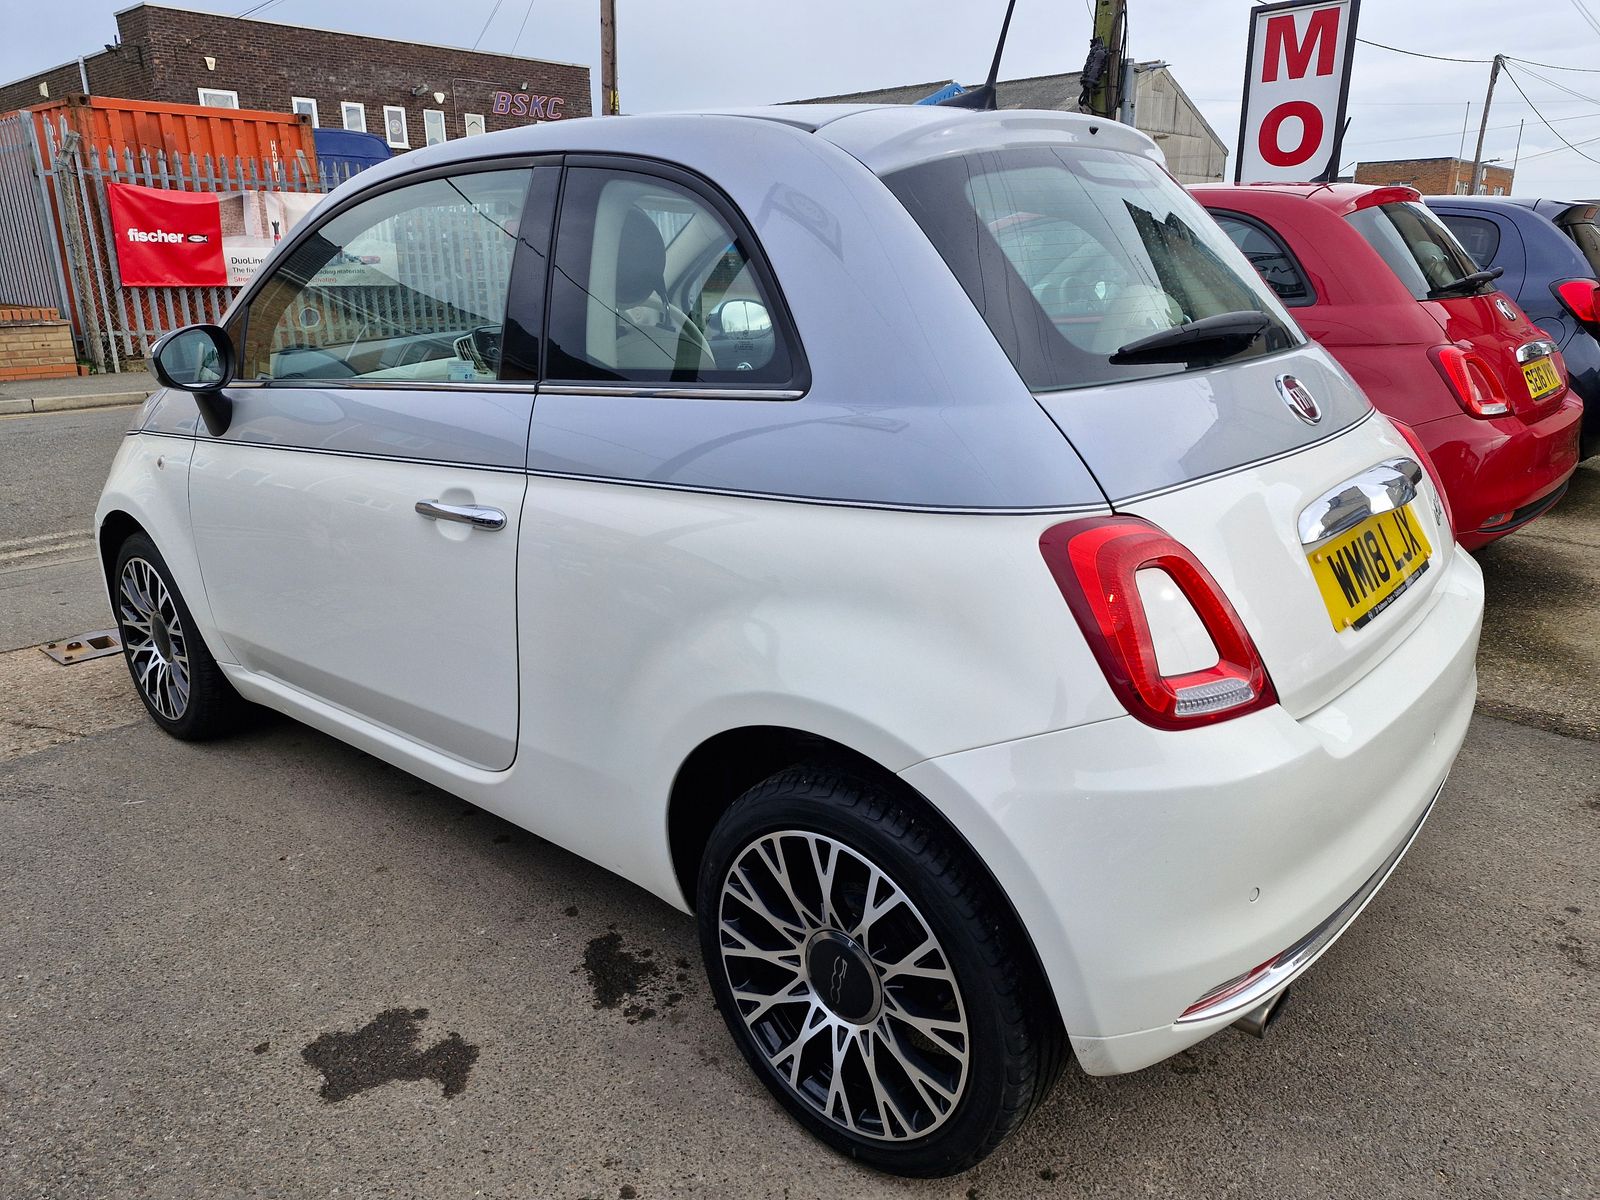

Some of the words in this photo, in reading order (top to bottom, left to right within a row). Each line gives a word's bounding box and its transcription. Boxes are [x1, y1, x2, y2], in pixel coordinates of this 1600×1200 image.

[492, 91, 564, 119] BSKC
[127, 227, 184, 243] fischer
[1327, 530, 1391, 609] WM18
[1377, 506, 1422, 572] LJX
